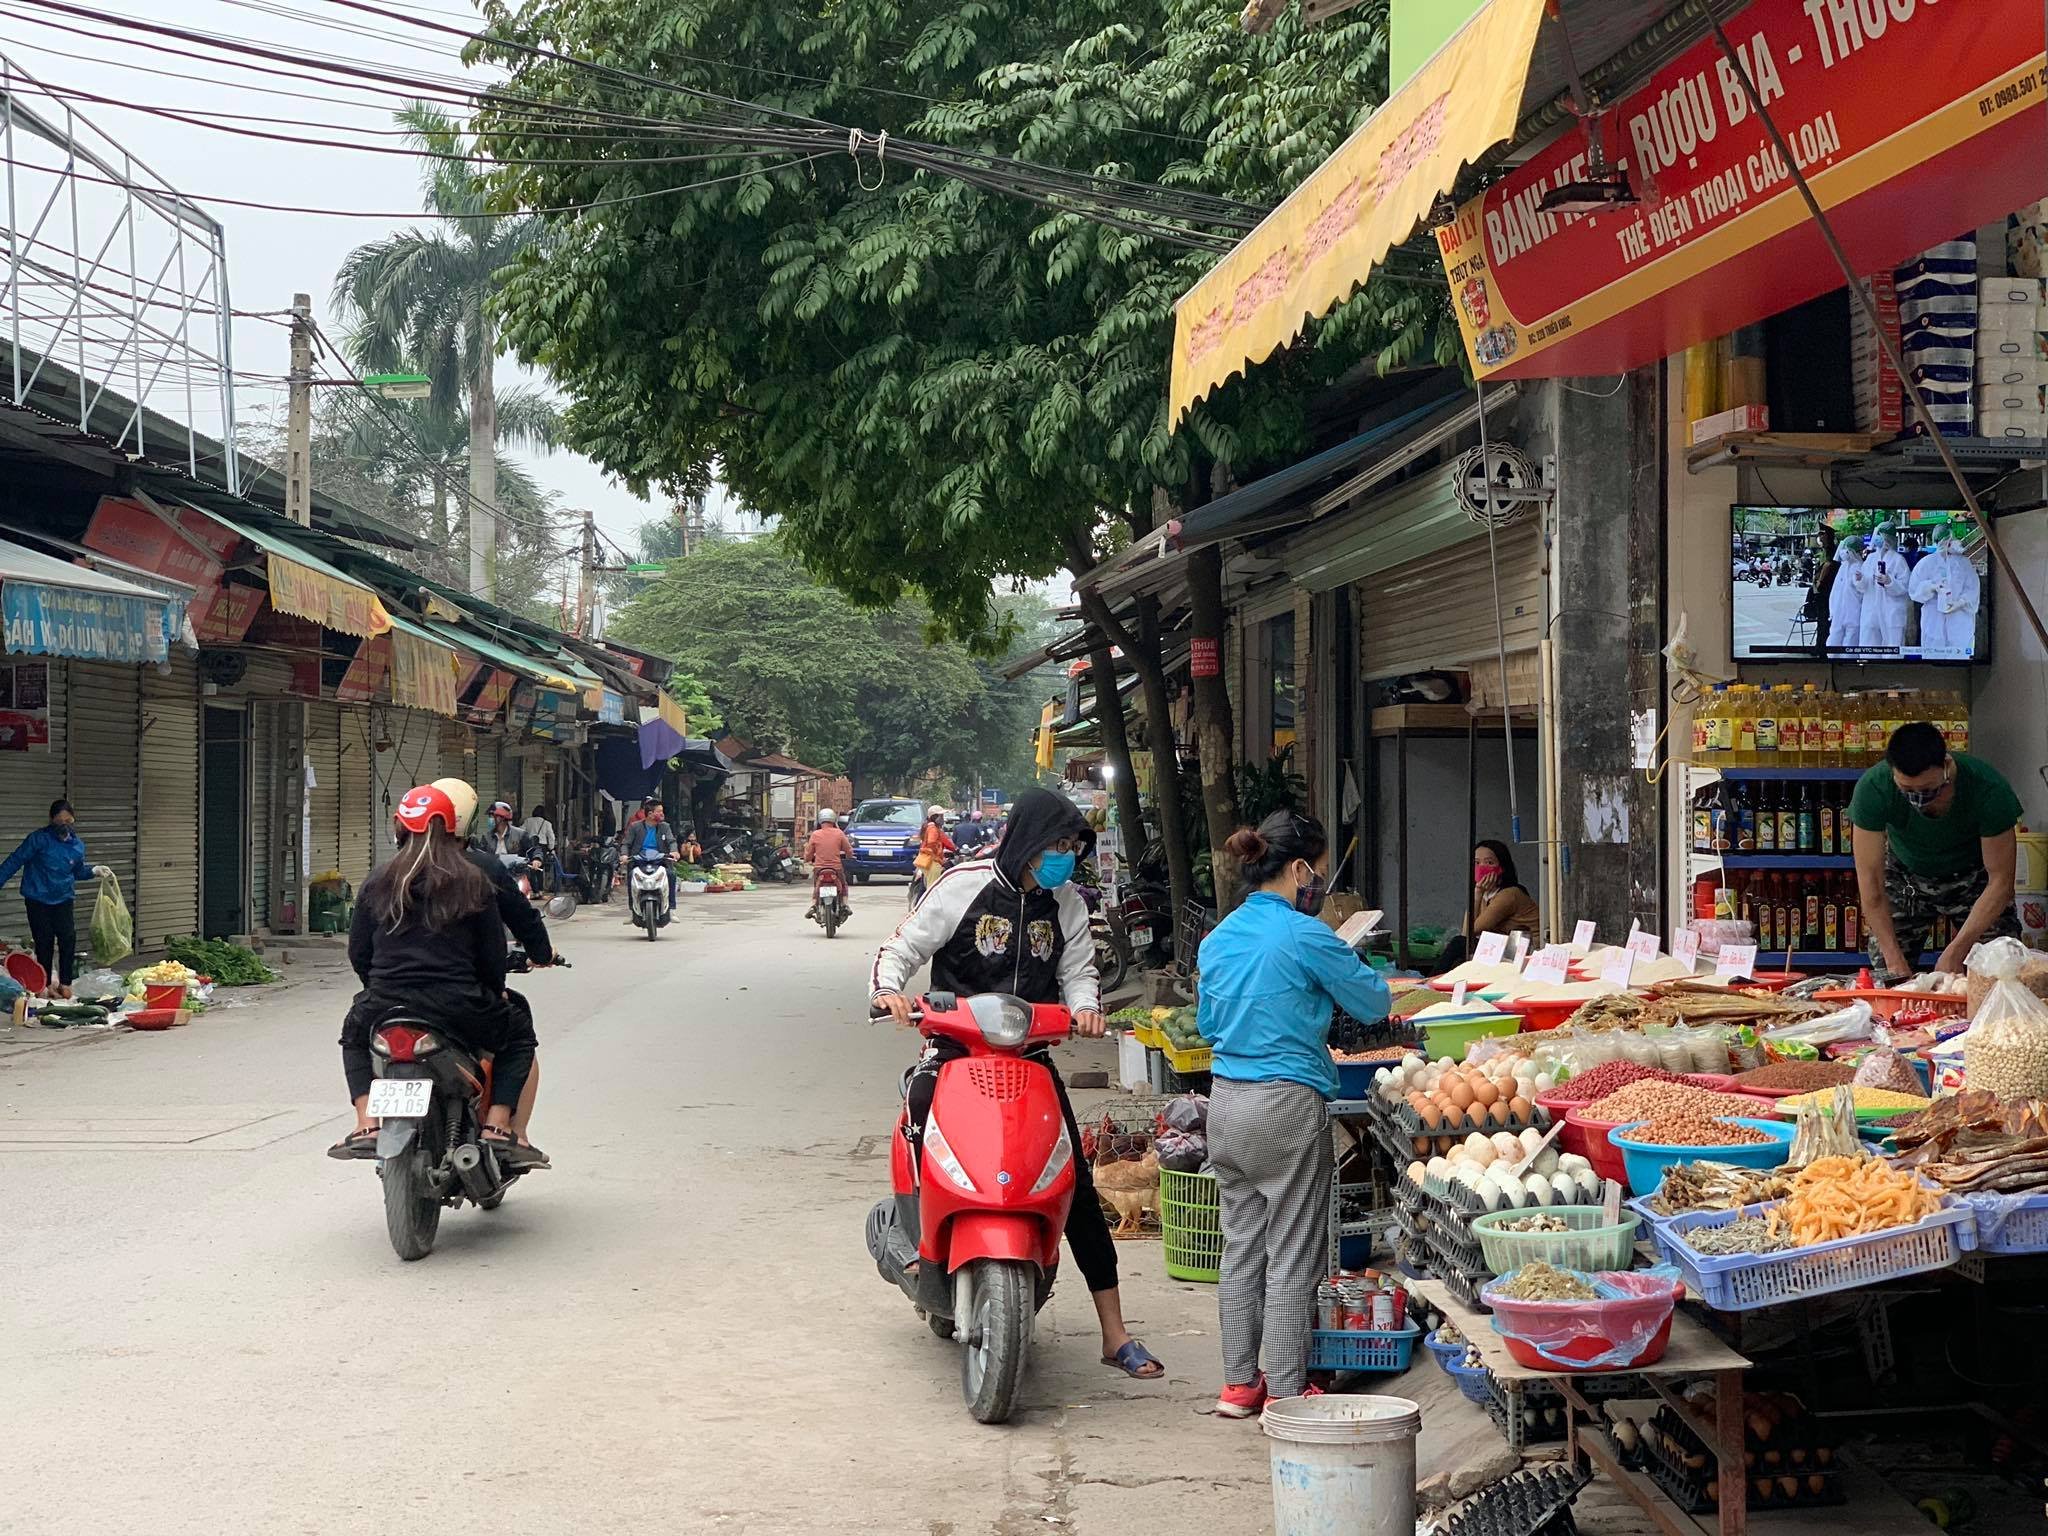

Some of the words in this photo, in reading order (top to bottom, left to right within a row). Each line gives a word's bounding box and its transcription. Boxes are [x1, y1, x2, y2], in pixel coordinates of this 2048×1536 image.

[1994, 73, 2038, 109] 0988.501
[1486, 178, 1558, 266] BÁNH
[1629, 71, 1717, 181] RƯỢU
[1715, 31, 1785, 127] BIA
[1616, 208, 1650, 264] THẺ
[1649, 195, 1694, 248] ĐIỆN
[1691, 163, 1748, 224] THOẠI
[1746, 140, 1790, 194] CÁC
[1788, 110, 1841, 171] LOẠI
[1439, 222, 1462, 255] ĐẠI
[1463, 208, 1478, 241] LÝ
[1449, 259, 1471, 286] THÚY
[1470, 252, 1486, 276] NGA
[371, 1099, 424, 1114] 521.05
[379, 1082, 422, 1097] 35-B2
